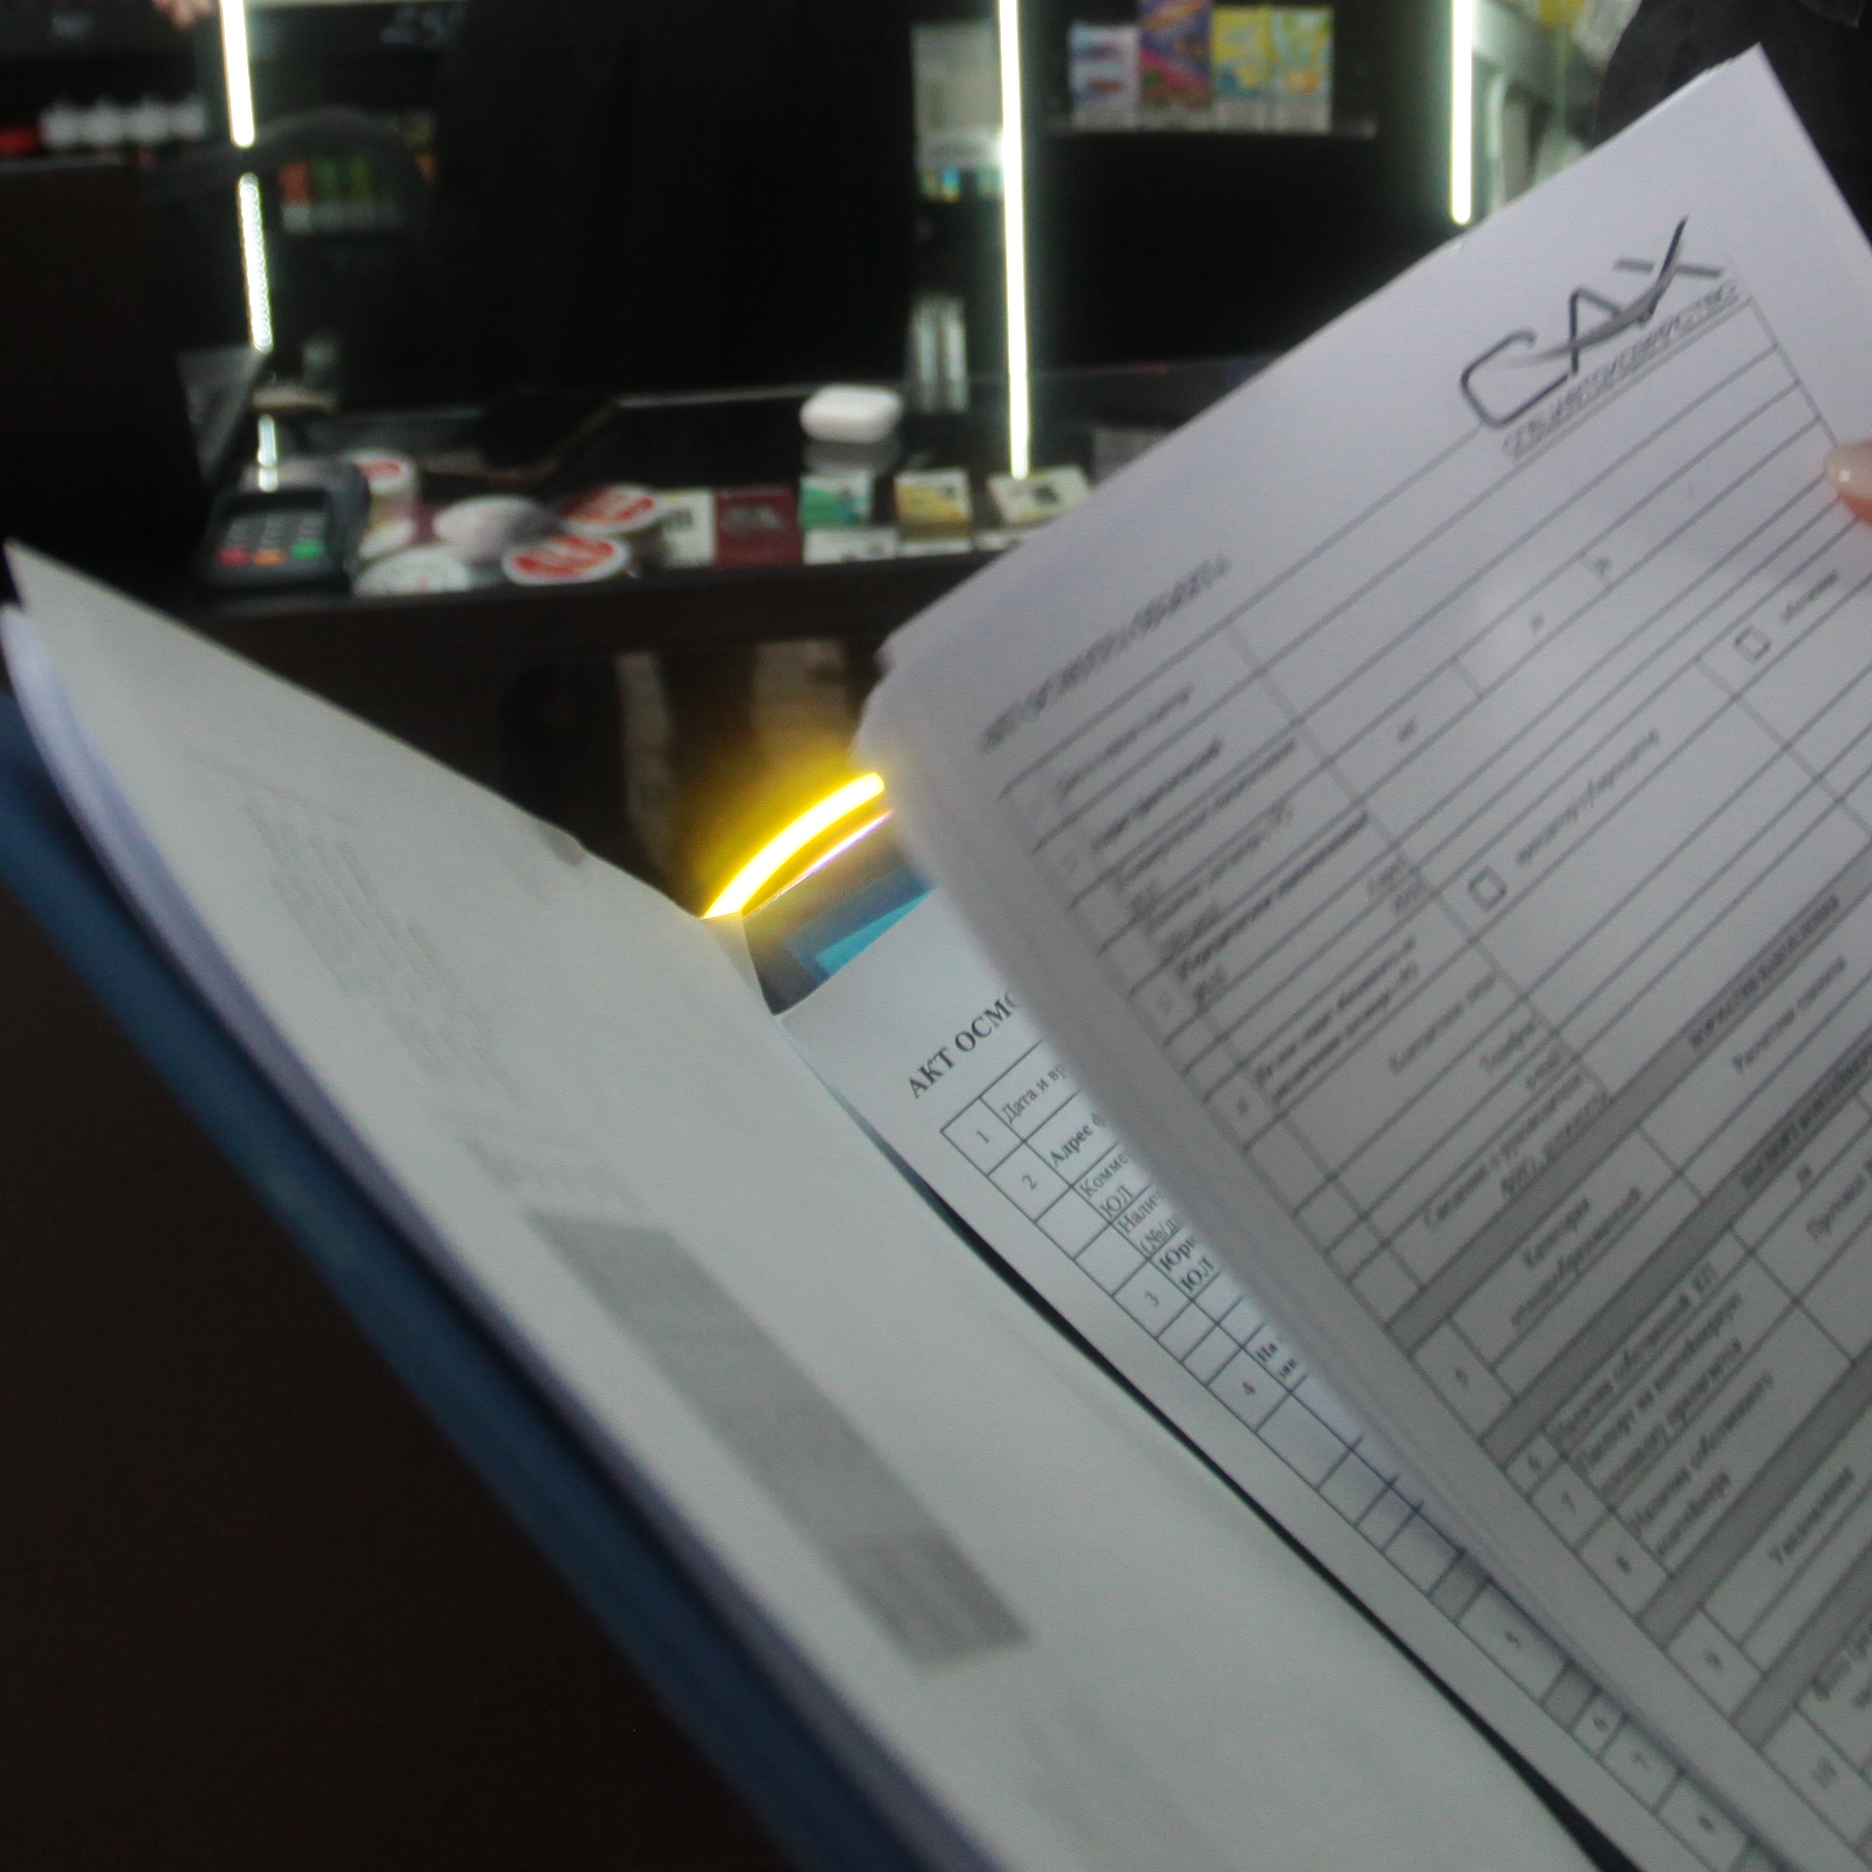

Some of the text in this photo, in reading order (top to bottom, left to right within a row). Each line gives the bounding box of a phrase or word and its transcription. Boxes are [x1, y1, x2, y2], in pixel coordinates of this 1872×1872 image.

[902, 1044, 959, 1101] АКТ
[999, 1084, 1040, 1125] Дата
[1046, 1121, 1097, 1171] Адрес
[1099, 1183, 1135, 1219] ЮЛ
[1178, 1256, 1216, 1293] ЮЛ
